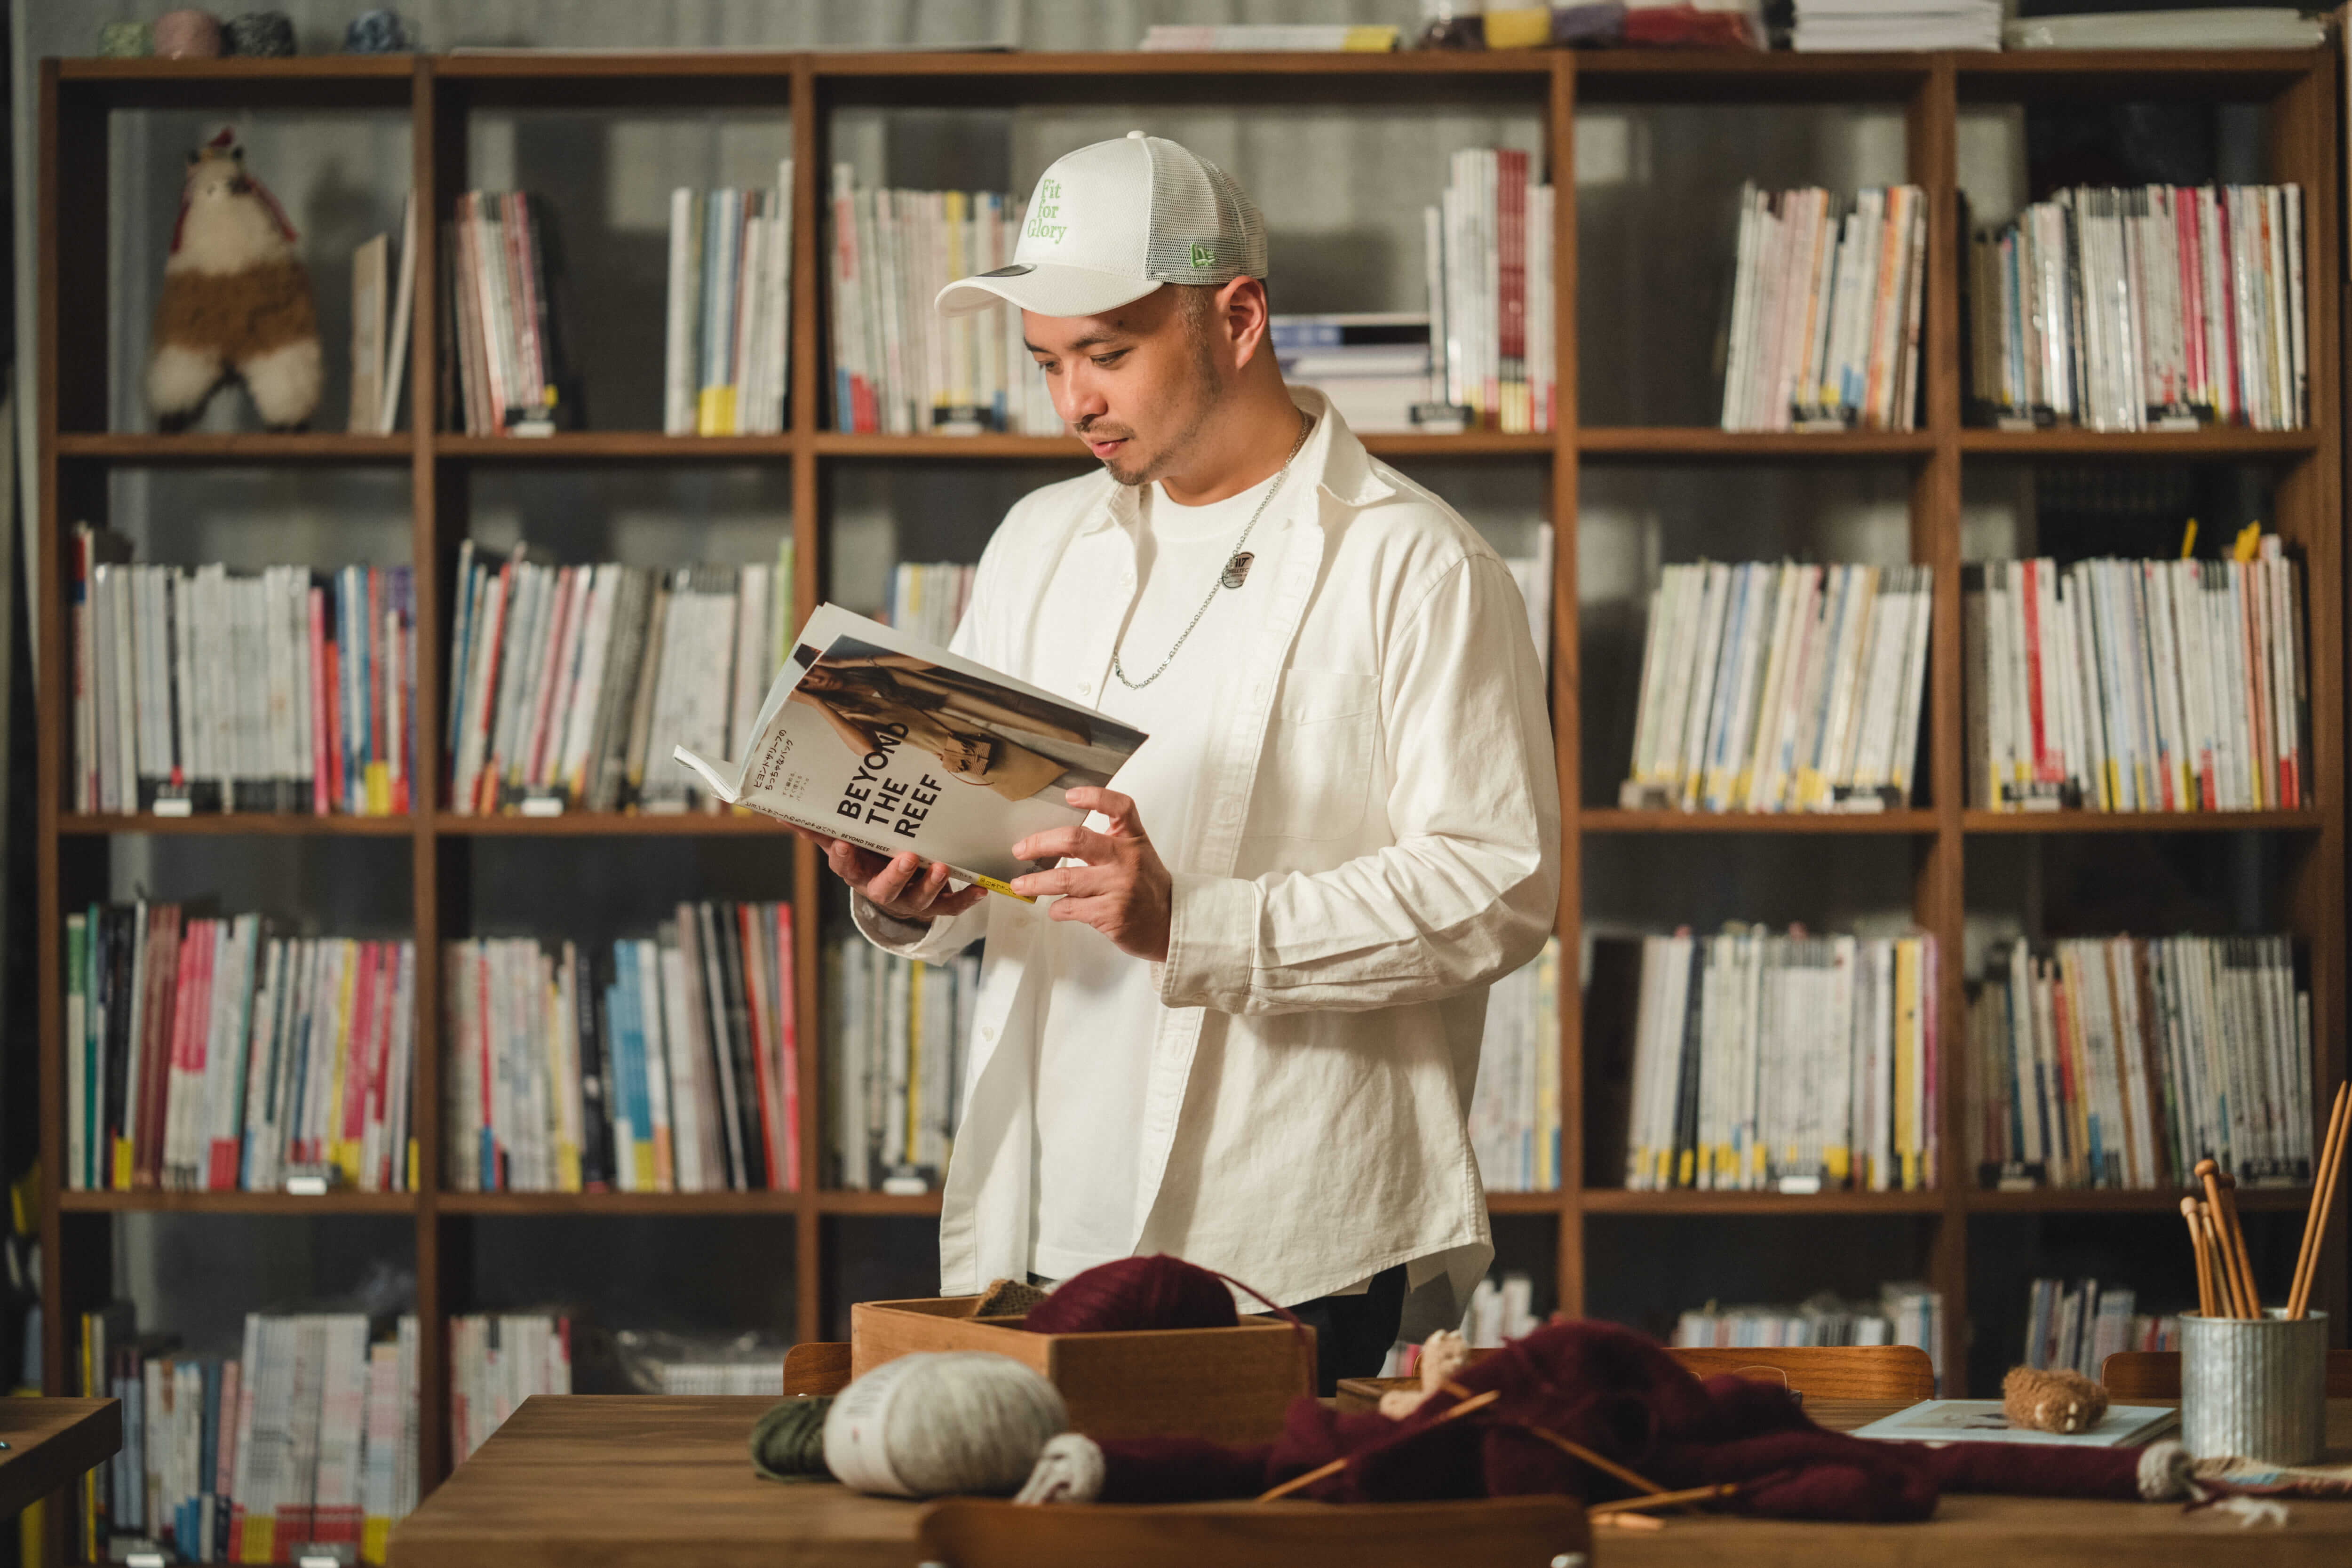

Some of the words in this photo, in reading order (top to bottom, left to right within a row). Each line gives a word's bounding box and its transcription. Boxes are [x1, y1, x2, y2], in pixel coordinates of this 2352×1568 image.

[1037, 199, 1059, 219] for
[1041, 178, 1062, 199] Fit
[1027, 218, 1067, 244] Glory
[754, 730, 787, 788] ビヨンドザリーフの
[765, 738, 794, 791] ちっちゃなバッグ
[837, 722, 909, 820] BEYOND
[865, 777, 909, 824] THE
[894, 774, 942, 838] REEF
[841, 833, 864, 844] BEYOND
